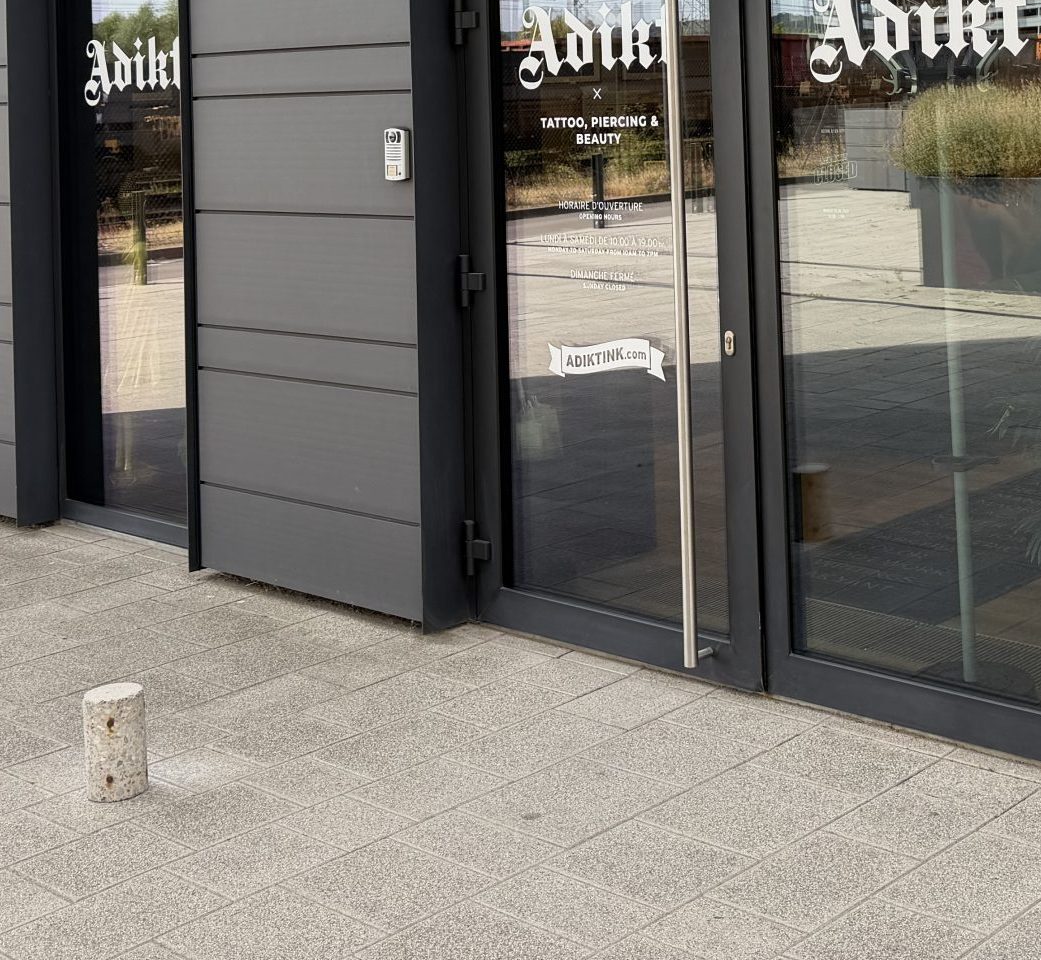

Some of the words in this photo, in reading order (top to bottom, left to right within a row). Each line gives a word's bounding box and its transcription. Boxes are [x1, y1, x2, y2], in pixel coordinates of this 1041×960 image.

[540, 117, 588, 130] TATTOO,
[591, 115, 647, 128] PIERCING
[650, 116, 659, 127] &
[576, 133, 621, 145] BEAUTY
[558, 200, 590, 211] HORAIRE
[592, 201, 644, 212] D'OUVERTURE
[569, 235, 597, 246] SAMEDI
[598, 236, 608, 246] DE
[570, 269, 608, 281] DIMANCHE
[566, 346, 647, 368] ADIKTINK.com
